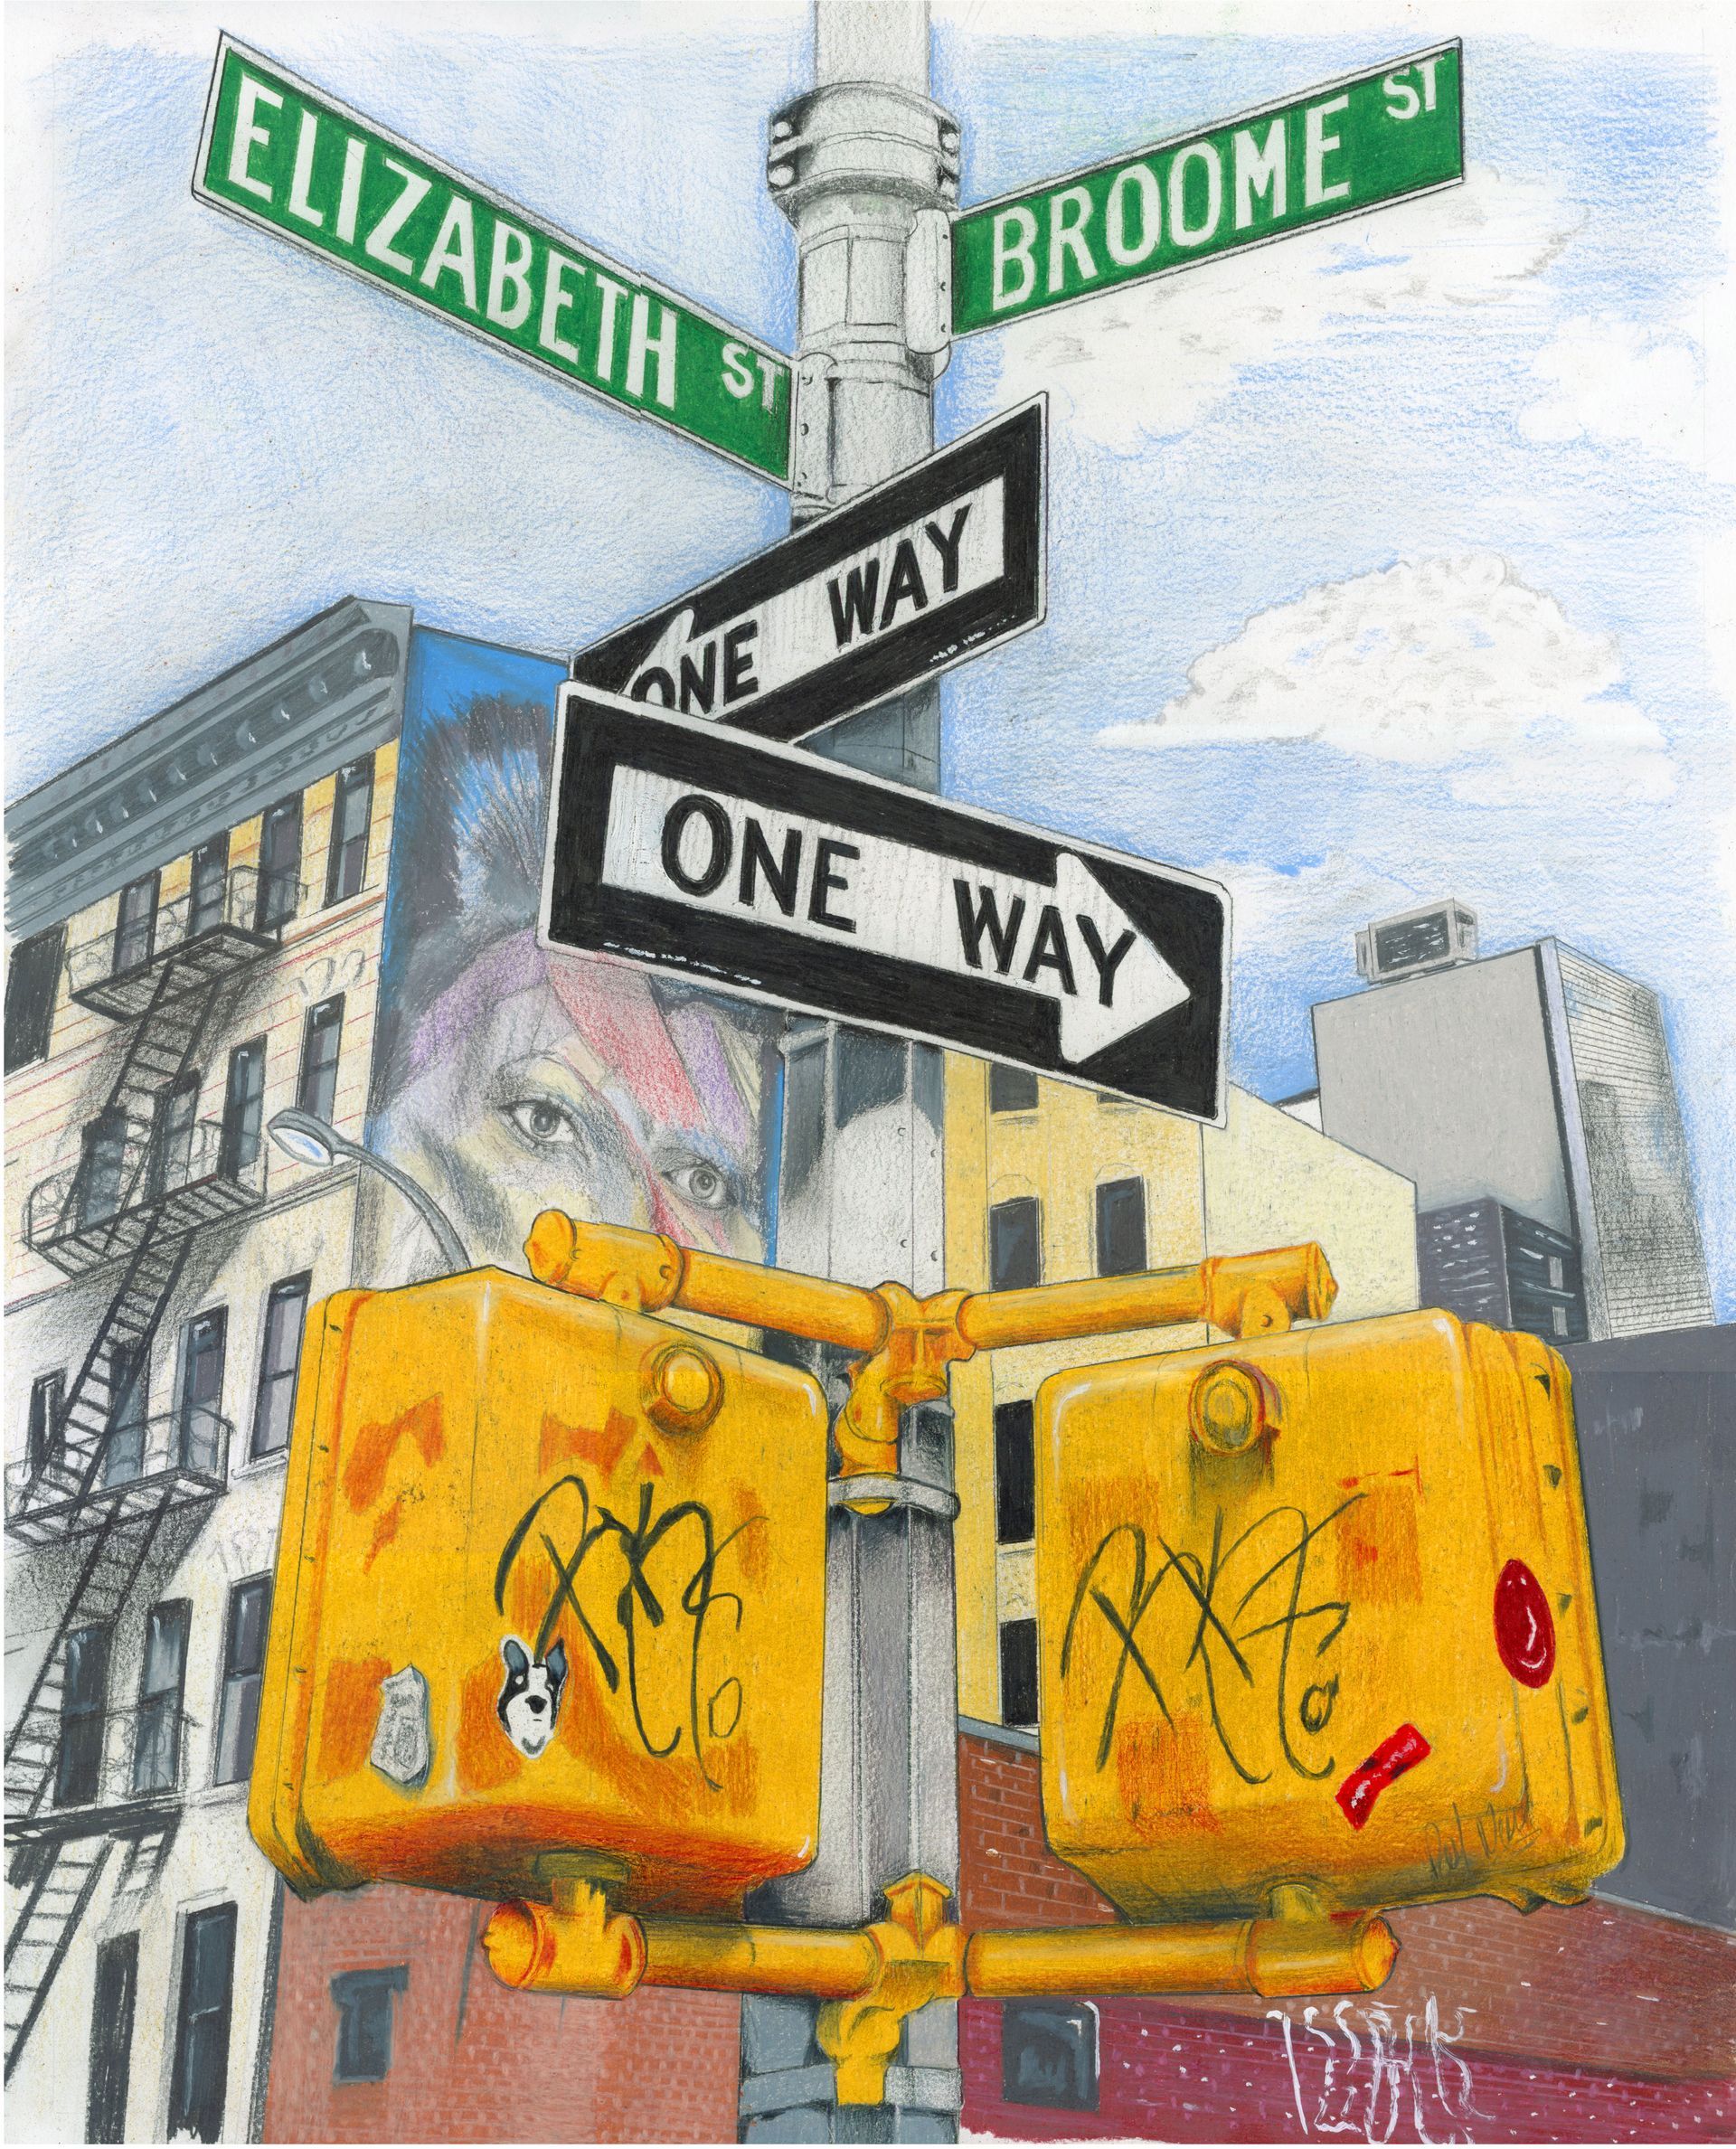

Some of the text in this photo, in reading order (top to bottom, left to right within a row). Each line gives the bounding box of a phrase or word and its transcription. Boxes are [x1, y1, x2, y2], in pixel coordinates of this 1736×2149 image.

[228, 71, 785, 415] ELIZABETH ST
[992, 53, 1445, 312] BROOME ST
[827, 504, 971, 649] WAY
[660, 793, 1137, 1008] ONE WAY
